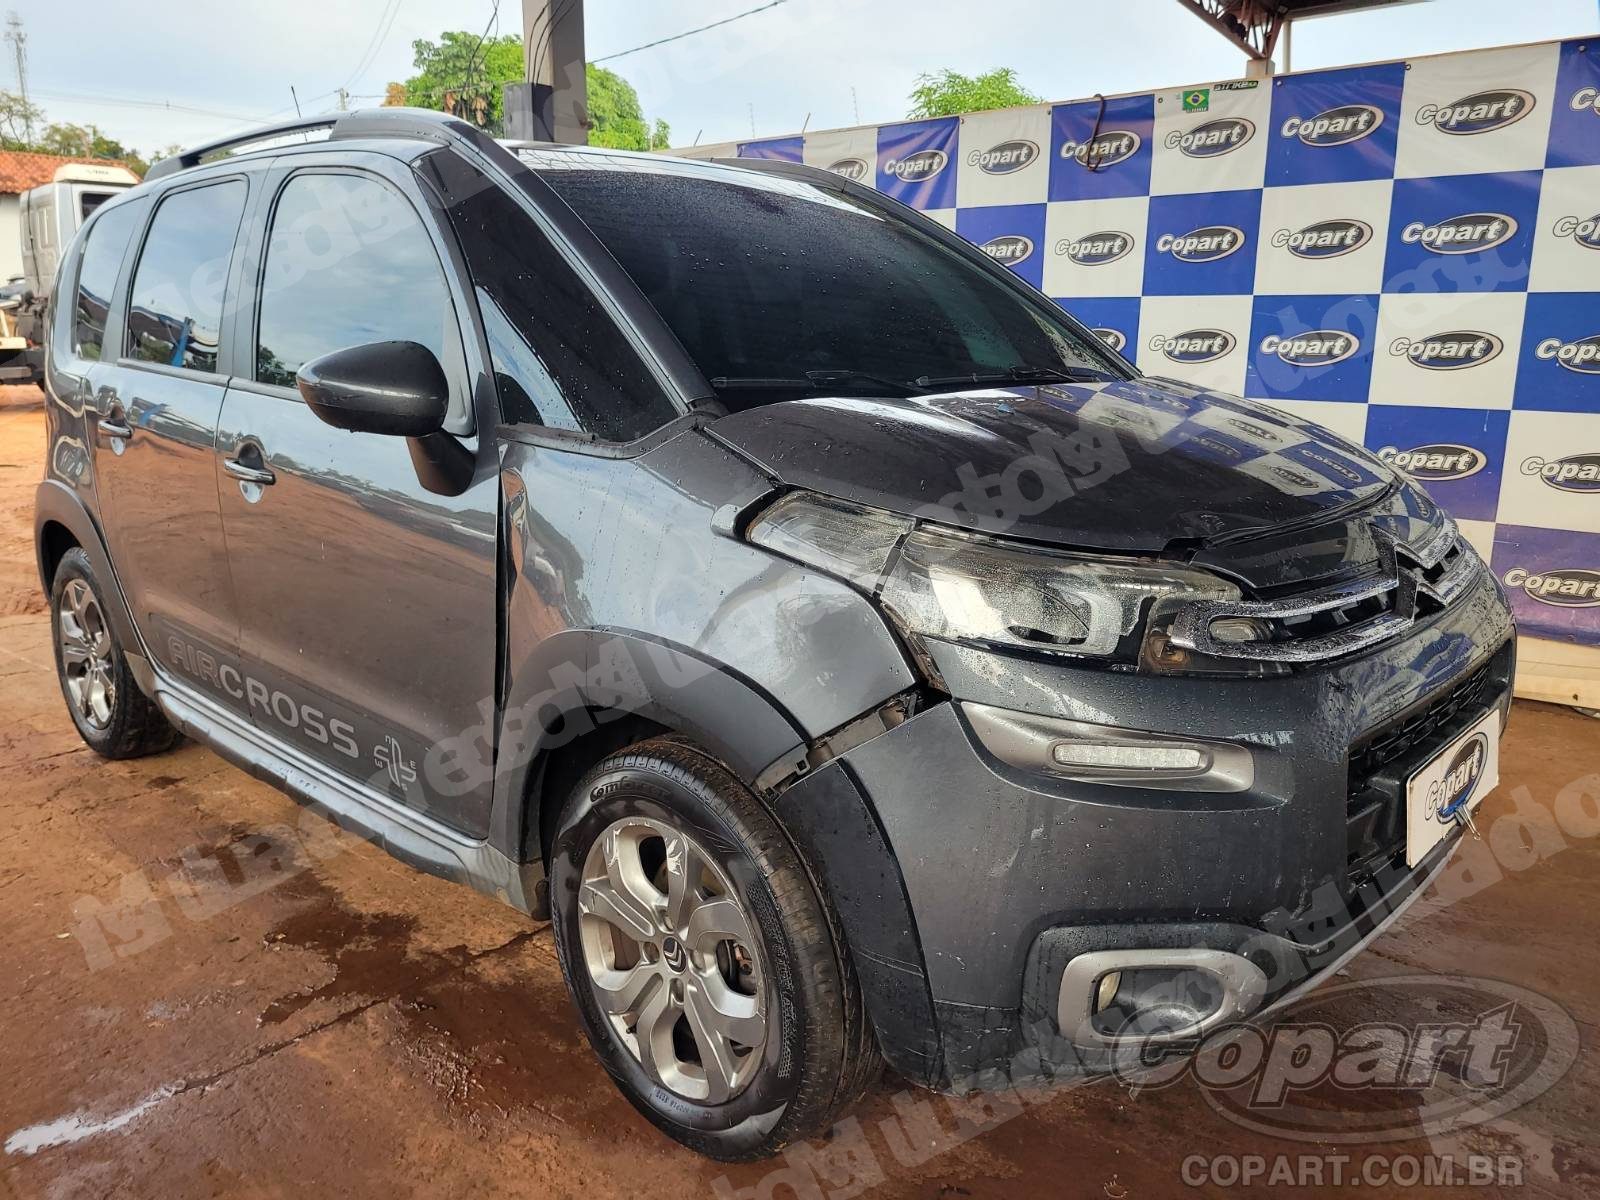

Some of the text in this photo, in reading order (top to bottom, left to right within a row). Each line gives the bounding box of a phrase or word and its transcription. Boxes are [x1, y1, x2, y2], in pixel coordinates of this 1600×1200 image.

[1415, 95, 1520, 127] Copart
[1281, 109, 1370, 140] Copart
[1164, 124, 1243, 152] Copart
[884, 154, 940, 176] Copart
[967, 146, 1029, 168] Copart
[1156, 231, 1233, 255] Copart
[1271, 225, 1359, 252] Copart
[1402, 218, 1503, 247] Copart
[1055, 238, 1123, 257] Copart
[1149, 334, 1226, 354] Copart
[1261, 335, 1348, 358] Copart
[1389, 337, 1489, 361] Copart
[1535, 338, 1600, 365] Cop
[1377, 446, 1472, 472] Copart
[168, 636, 359, 759] AIRCROSS
[1425, 740, 1480, 820] Copart
